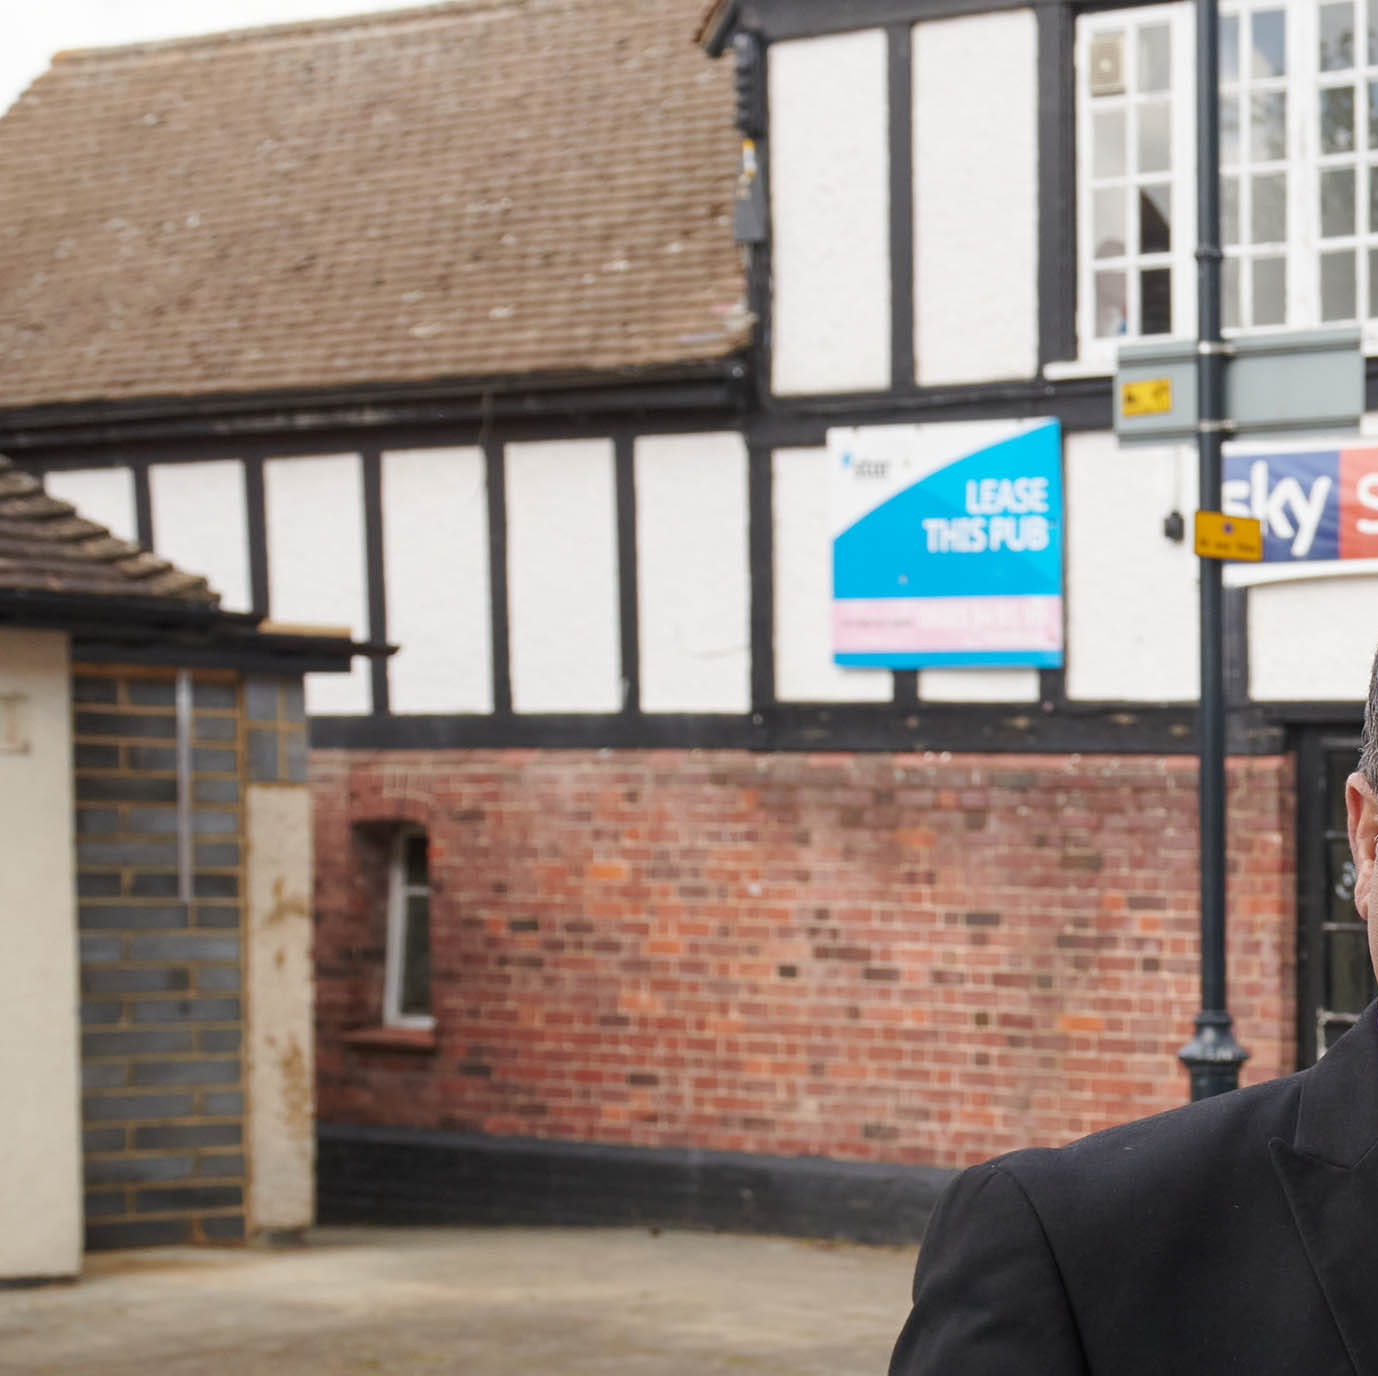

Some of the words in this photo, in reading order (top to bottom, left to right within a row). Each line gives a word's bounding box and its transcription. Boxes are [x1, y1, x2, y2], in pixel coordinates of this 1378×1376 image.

[965, 477, 1049, 515] LEASE
[1220, 459, 1332, 557] sky
[921, 516, 987, 553] THIS
[988, 514, 1050, 552] PUB
